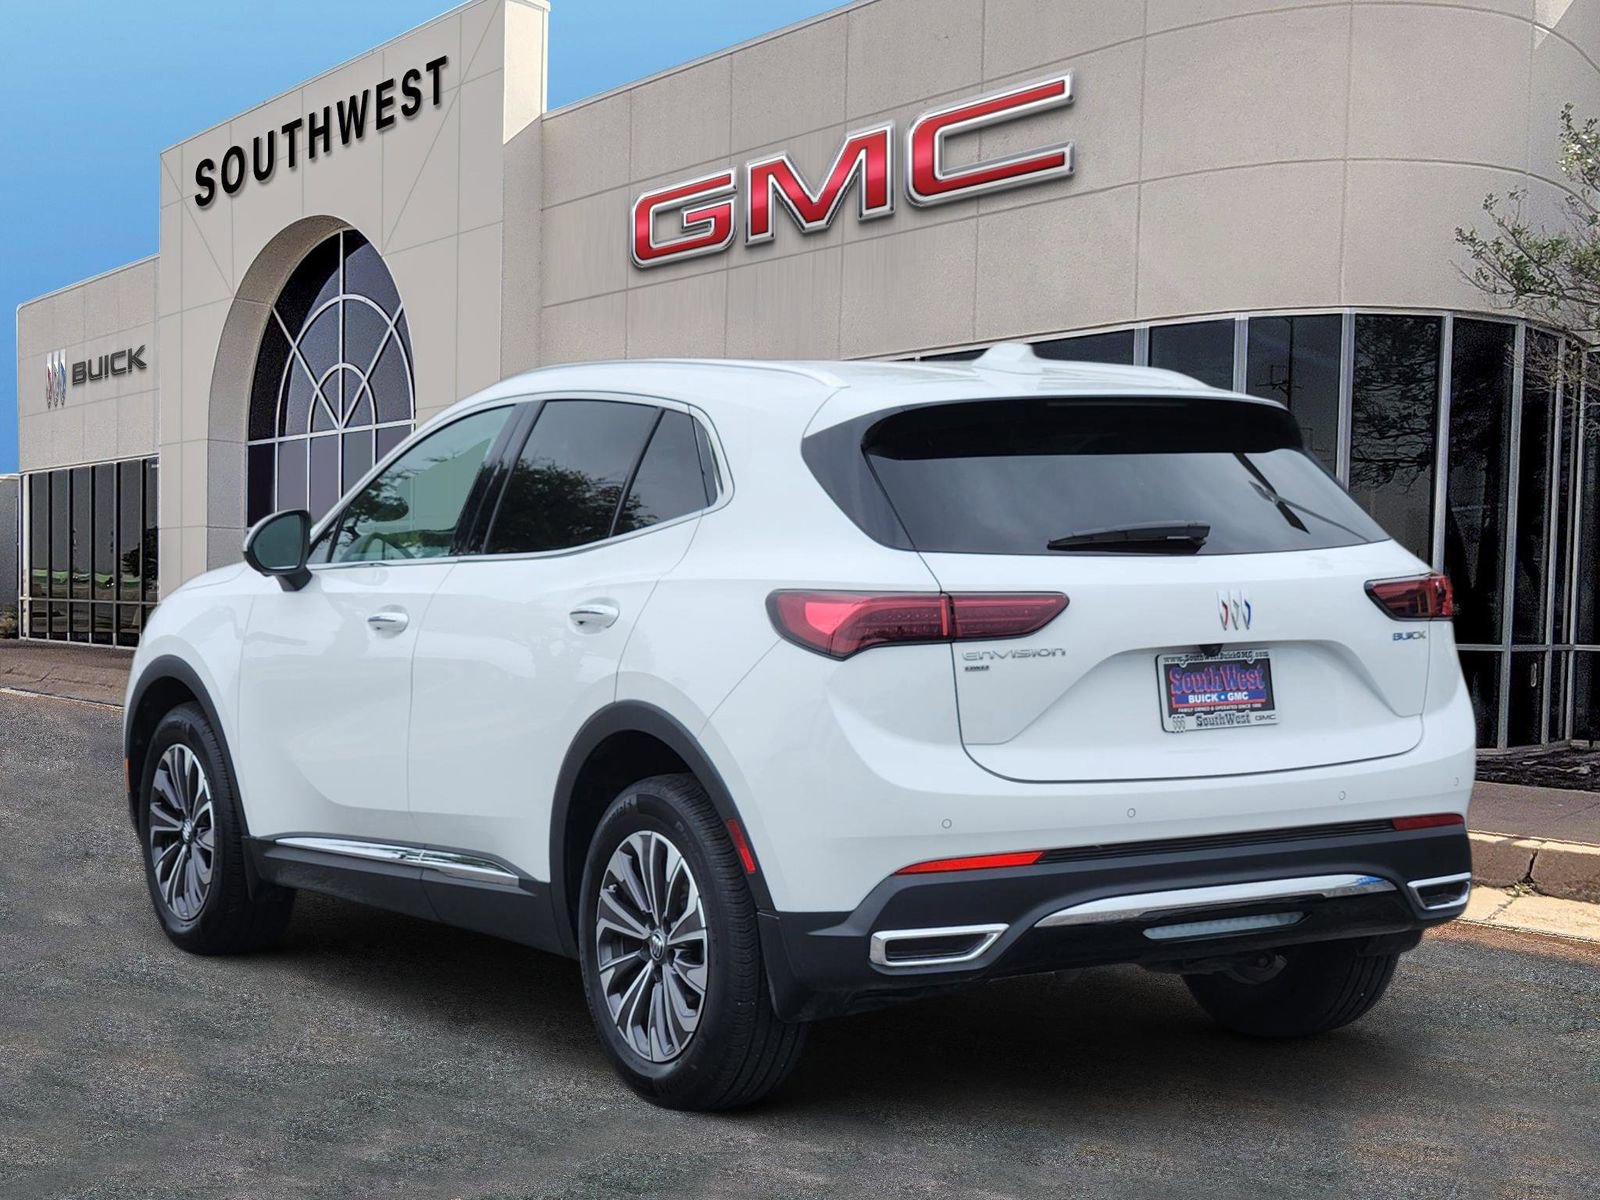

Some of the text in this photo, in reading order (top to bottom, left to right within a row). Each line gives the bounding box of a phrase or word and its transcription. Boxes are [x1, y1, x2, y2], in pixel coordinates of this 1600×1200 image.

[194, 55, 449, 208] SOUTHWEST
[630, 69, 1075, 268] GMC
[72, 344, 147, 385] BUICK
[1392, 630, 1426, 641] BUICK
[1188, 691, 1249, 704] BUICK GMC
[1196, 711, 1276, 727] SouthWest GMC
